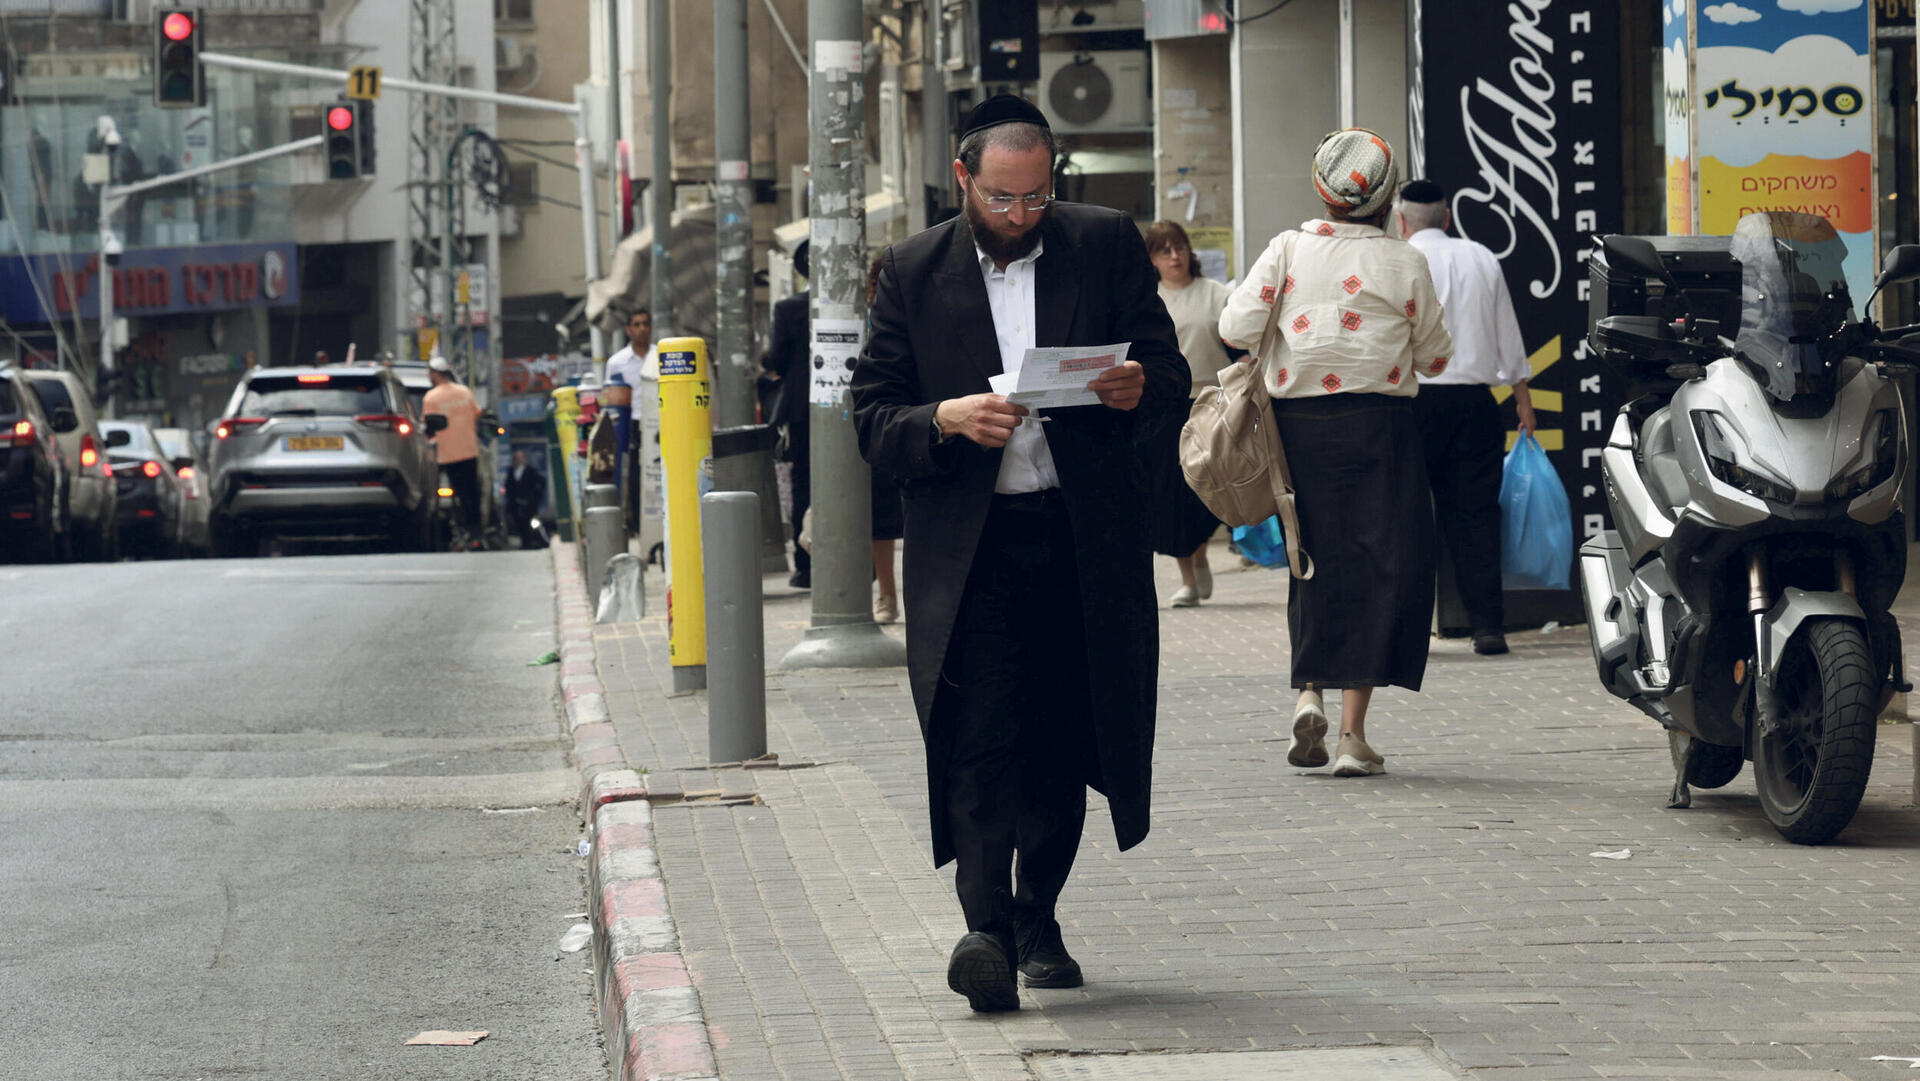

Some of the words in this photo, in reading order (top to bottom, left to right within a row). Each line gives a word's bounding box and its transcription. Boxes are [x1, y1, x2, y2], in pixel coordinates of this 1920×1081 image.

[1570, 11, 1593, 104] בית
[353, 69, 376, 95] 11
[1741, 173, 1838, 195] משחקים
[182, 263, 257, 303] מרכז
[1572, 338, 1605, 538] לגברים
